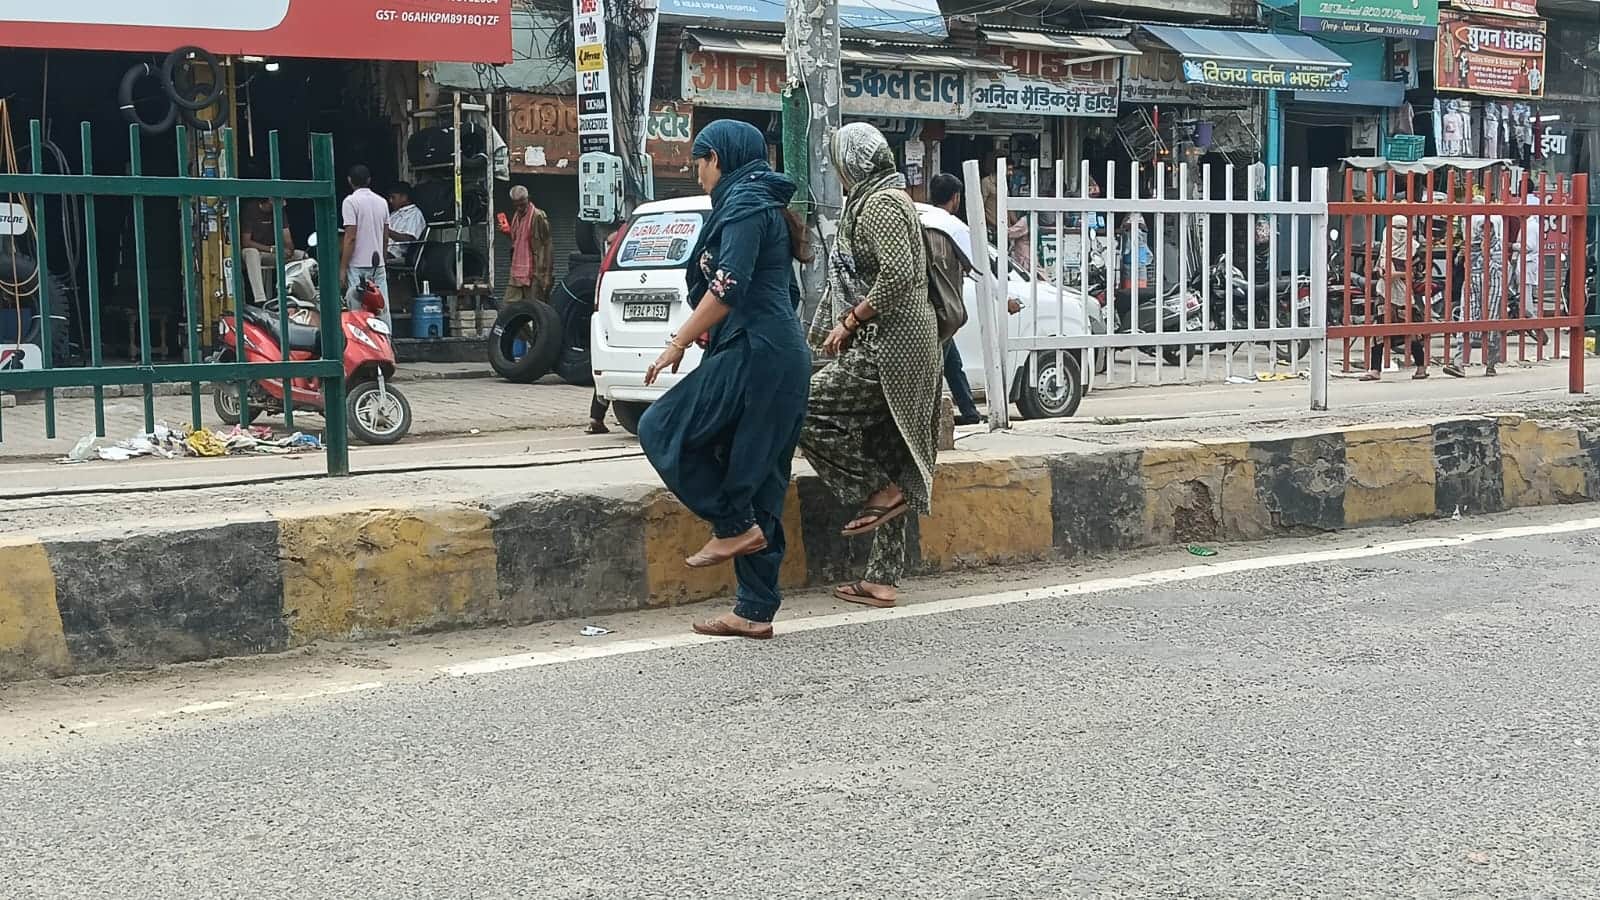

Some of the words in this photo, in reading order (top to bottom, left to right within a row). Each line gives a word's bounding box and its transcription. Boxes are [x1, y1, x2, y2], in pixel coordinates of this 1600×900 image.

[1468, 27, 1501, 51] सुमन
[1203, 60, 1247, 82] विजय
[974, 84, 1018, 105] अनिल
